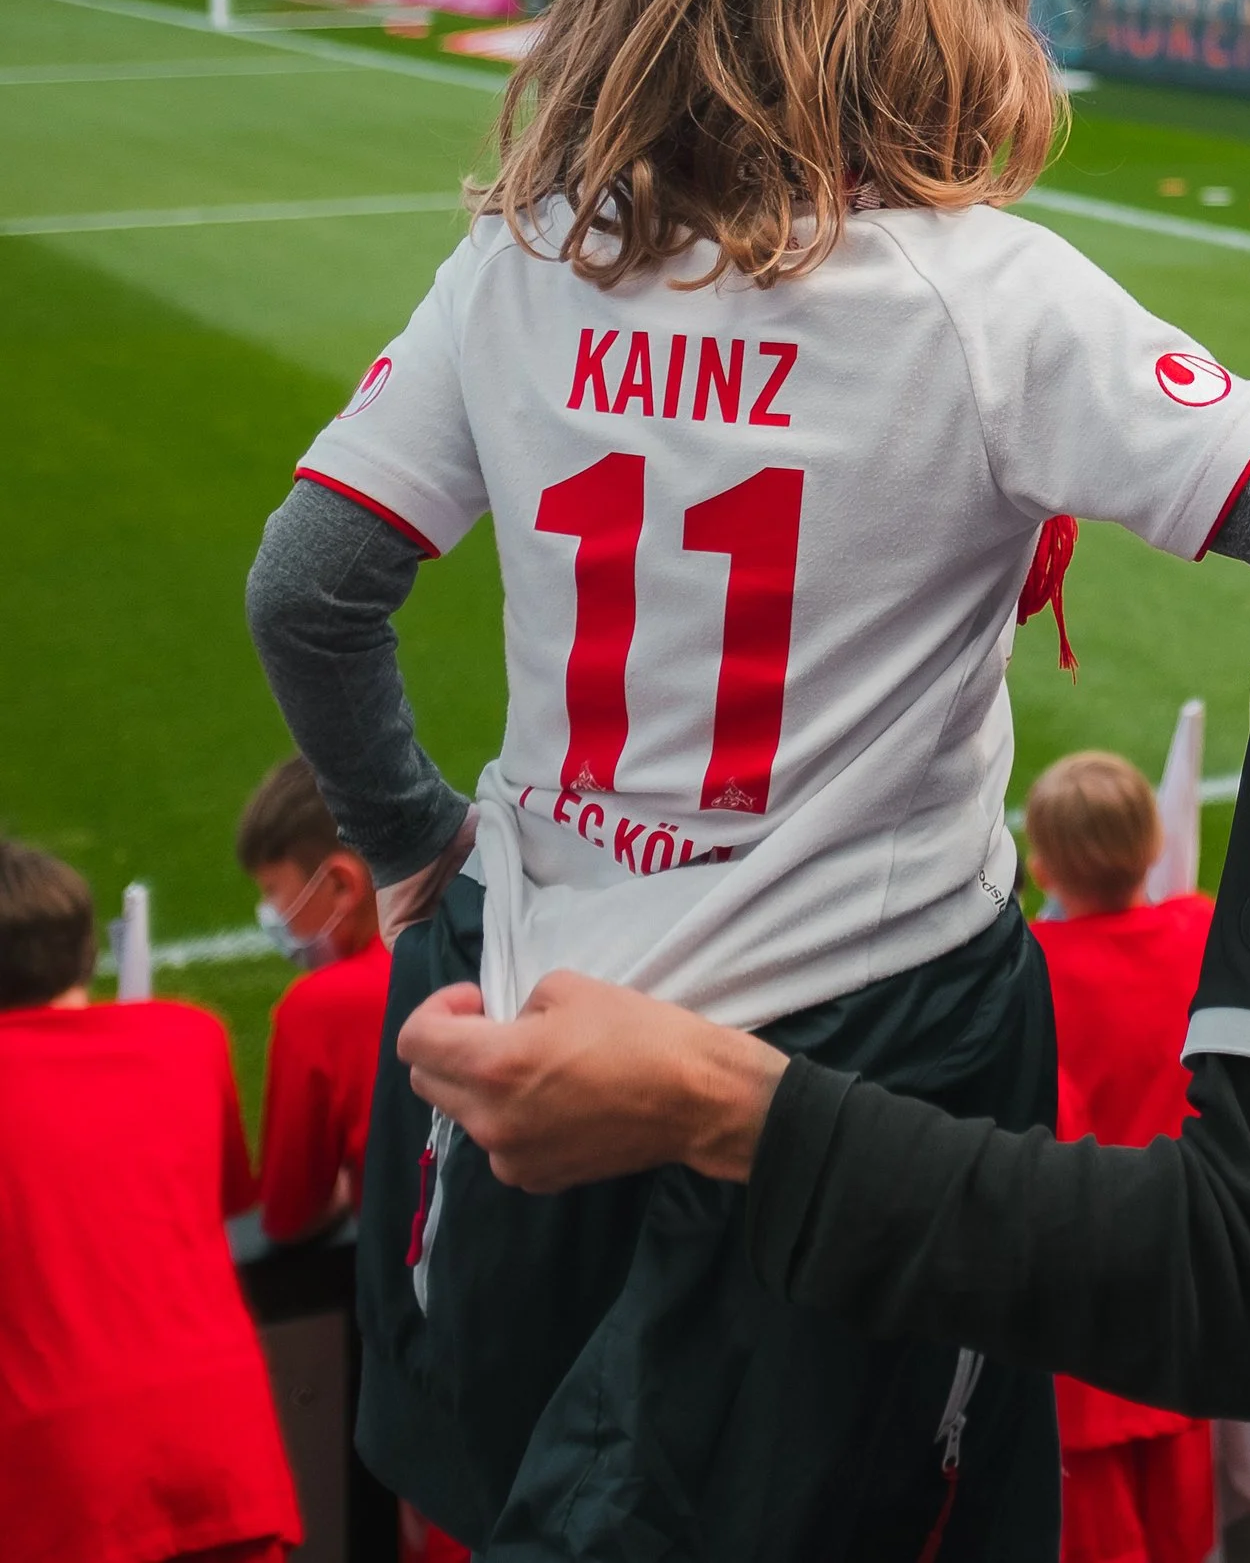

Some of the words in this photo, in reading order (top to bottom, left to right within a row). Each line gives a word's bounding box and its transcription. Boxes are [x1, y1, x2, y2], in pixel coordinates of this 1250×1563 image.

[566, 328, 799, 428] KAINZ
[533, 451, 805, 815] 11
[613, 817, 734, 877] KÖ
